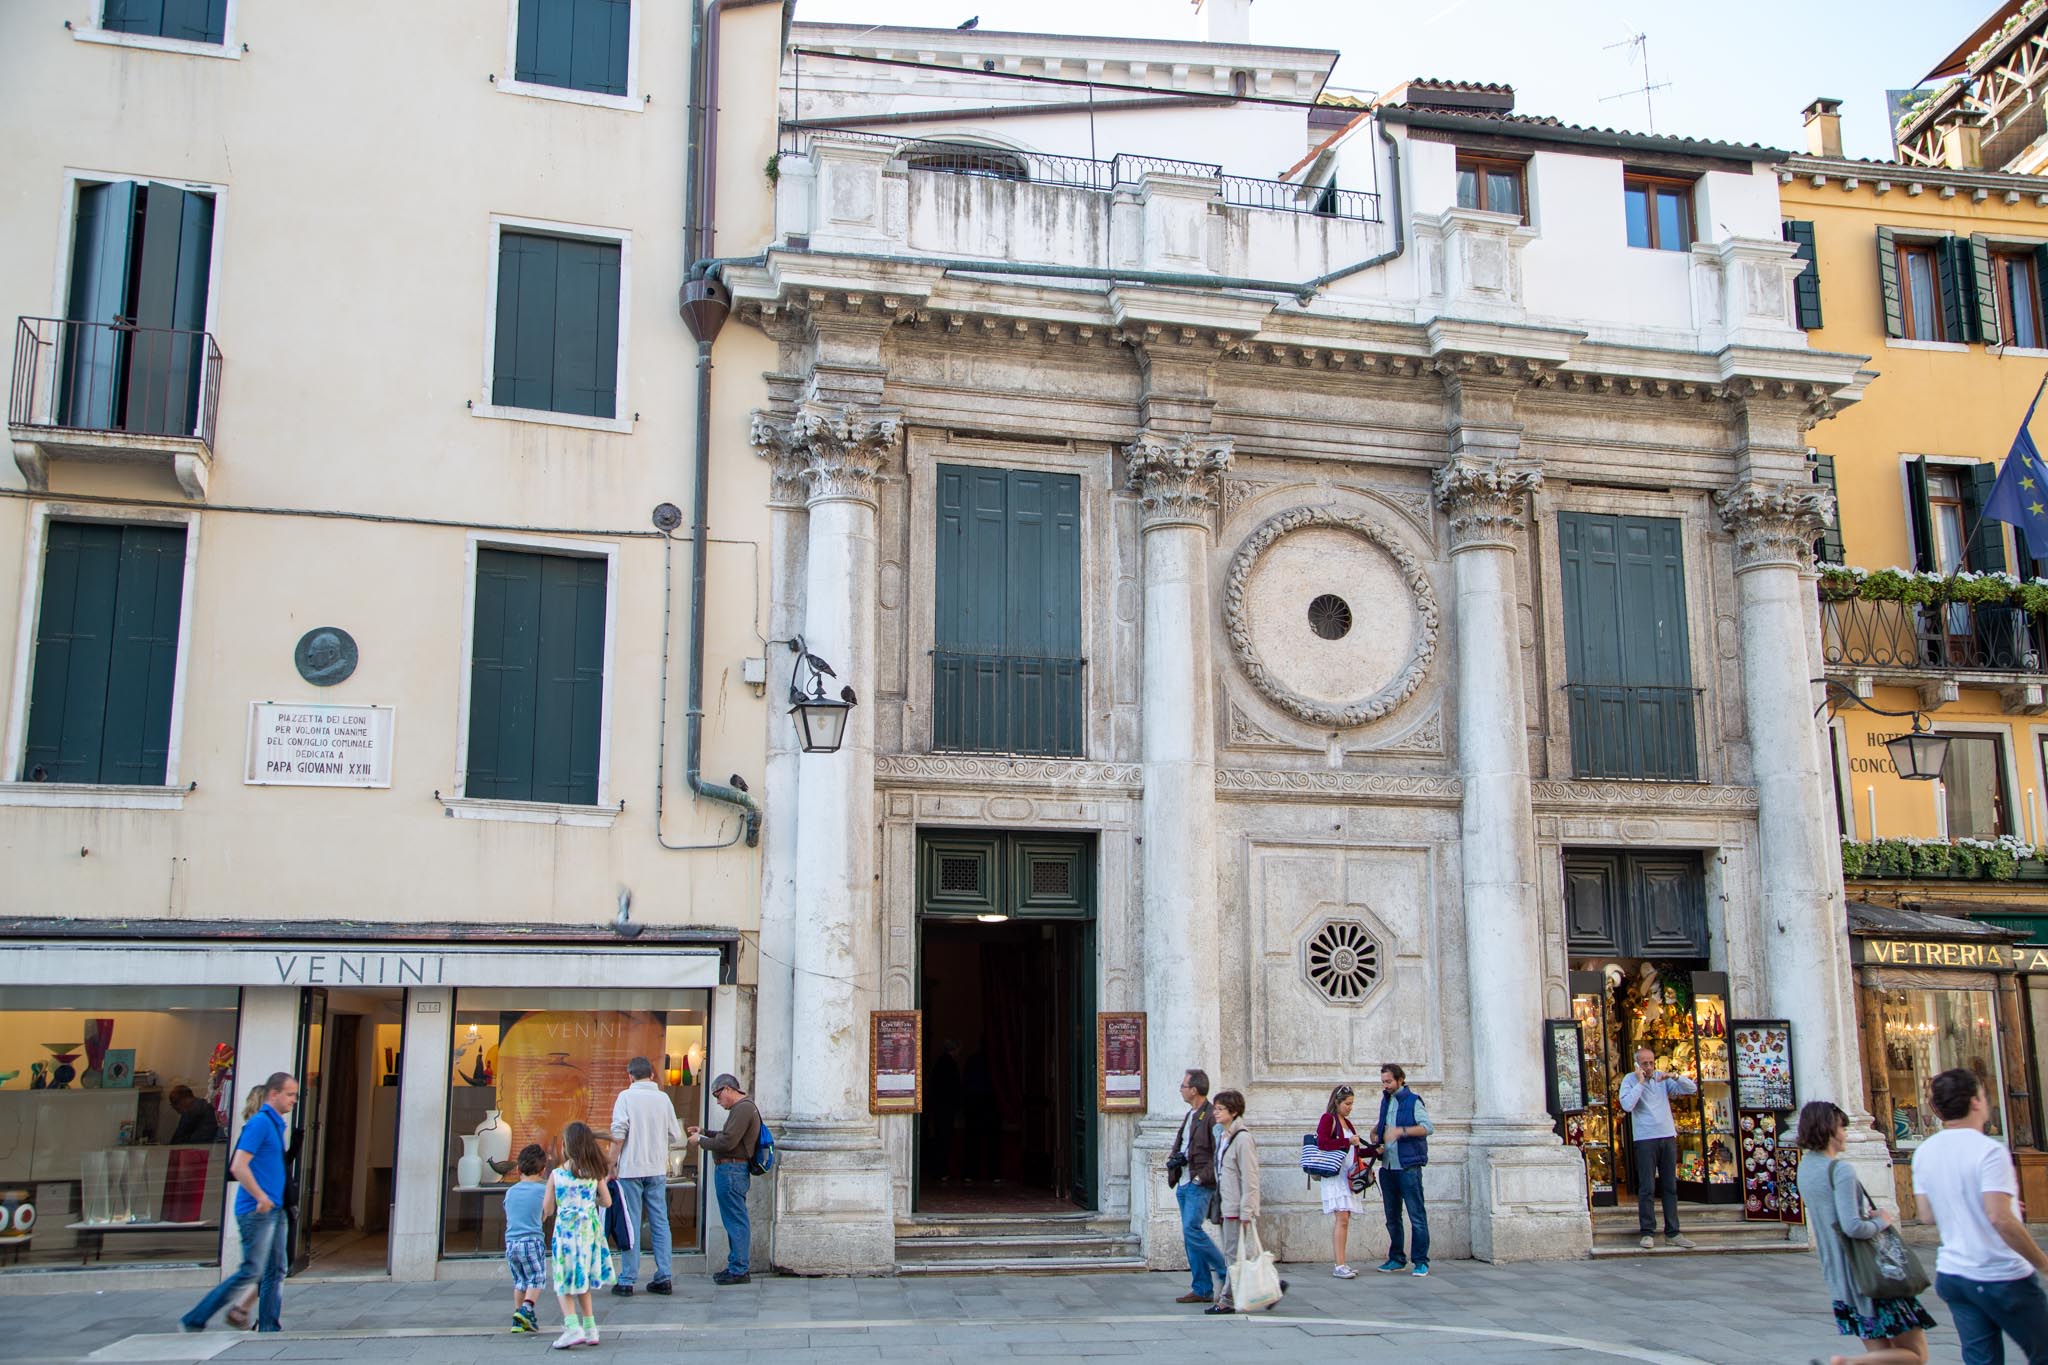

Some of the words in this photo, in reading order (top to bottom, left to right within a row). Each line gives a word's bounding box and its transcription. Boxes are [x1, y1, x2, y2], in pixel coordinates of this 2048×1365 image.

[278, 713, 323, 724] PIAZZETTA
[326, 715, 340, 724] DEI
[342, 716, 367, 725] LEONI
[275, 725, 291, 735] PER
[334, 728, 368, 737] UNANIME
[267, 737, 283, 746] DEL
[287, 737, 328, 747] CONSIGLIO
[331, 739, 374, 748] COMUNALE
[295, 749, 335, 759] DEDICATA
[338, 751, 344, 759] A
[266, 760, 292, 773] PAPA
[297, 761, 343, 775] GIOVANNI
[348, 763, 371, 775] XXIII
[1850, 757, 1897, 773] CONCO
[1871, 941, 2003, 967] VETRERIA
[275, 955, 443, 984] VENINI
[545, 1023, 622, 1039] VENINI
